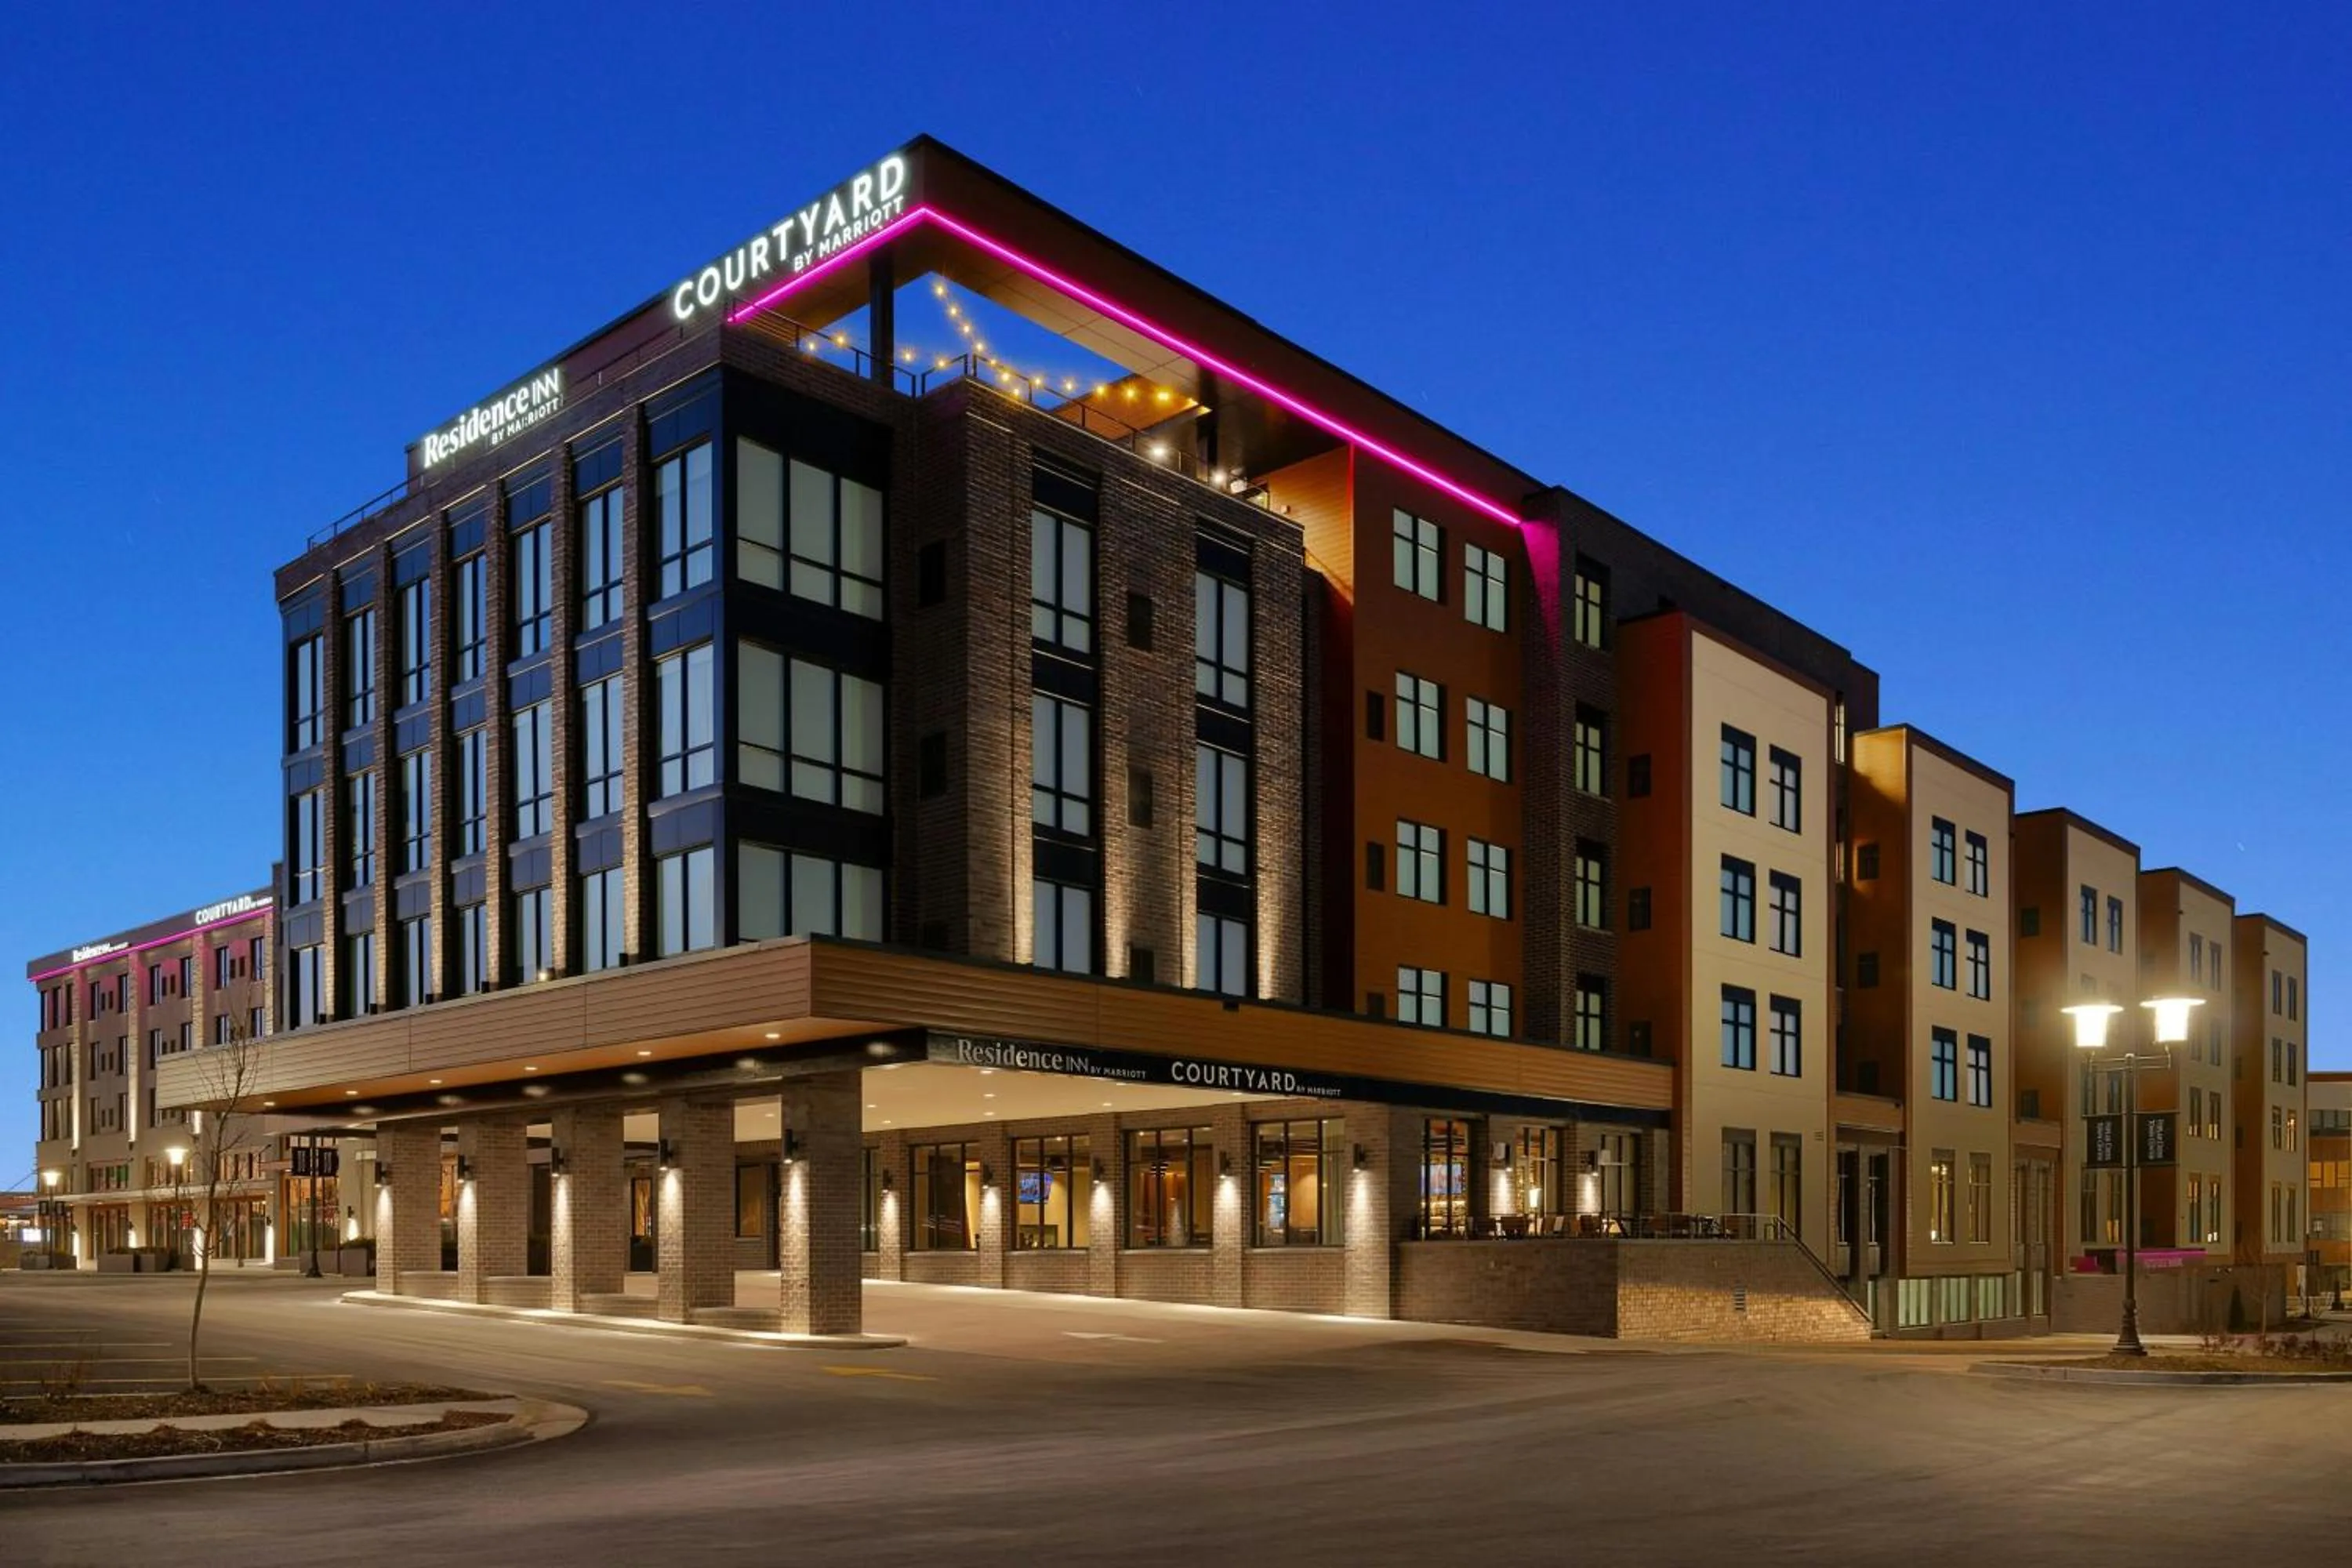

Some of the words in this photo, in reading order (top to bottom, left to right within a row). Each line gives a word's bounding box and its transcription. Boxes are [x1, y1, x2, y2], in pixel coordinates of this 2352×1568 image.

[673, 155, 905, 320] COURTYARD
[794, 248, 813, 272] BY
[819, 195, 904, 257] MARRIOTT
[423, 386, 529, 469] Residence
[532, 368, 559, 406] INN
[492, 430, 504, 445] BY
[958, 1039, 1064, 1070] Residence
[1066, 1055, 1089, 1073] INN
[1091, 1065, 1101, 1074] BY
[1104, 1067, 1147, 1080] MARRIOTT
[1171, 1062, 1296, 1091] COURTYARD
